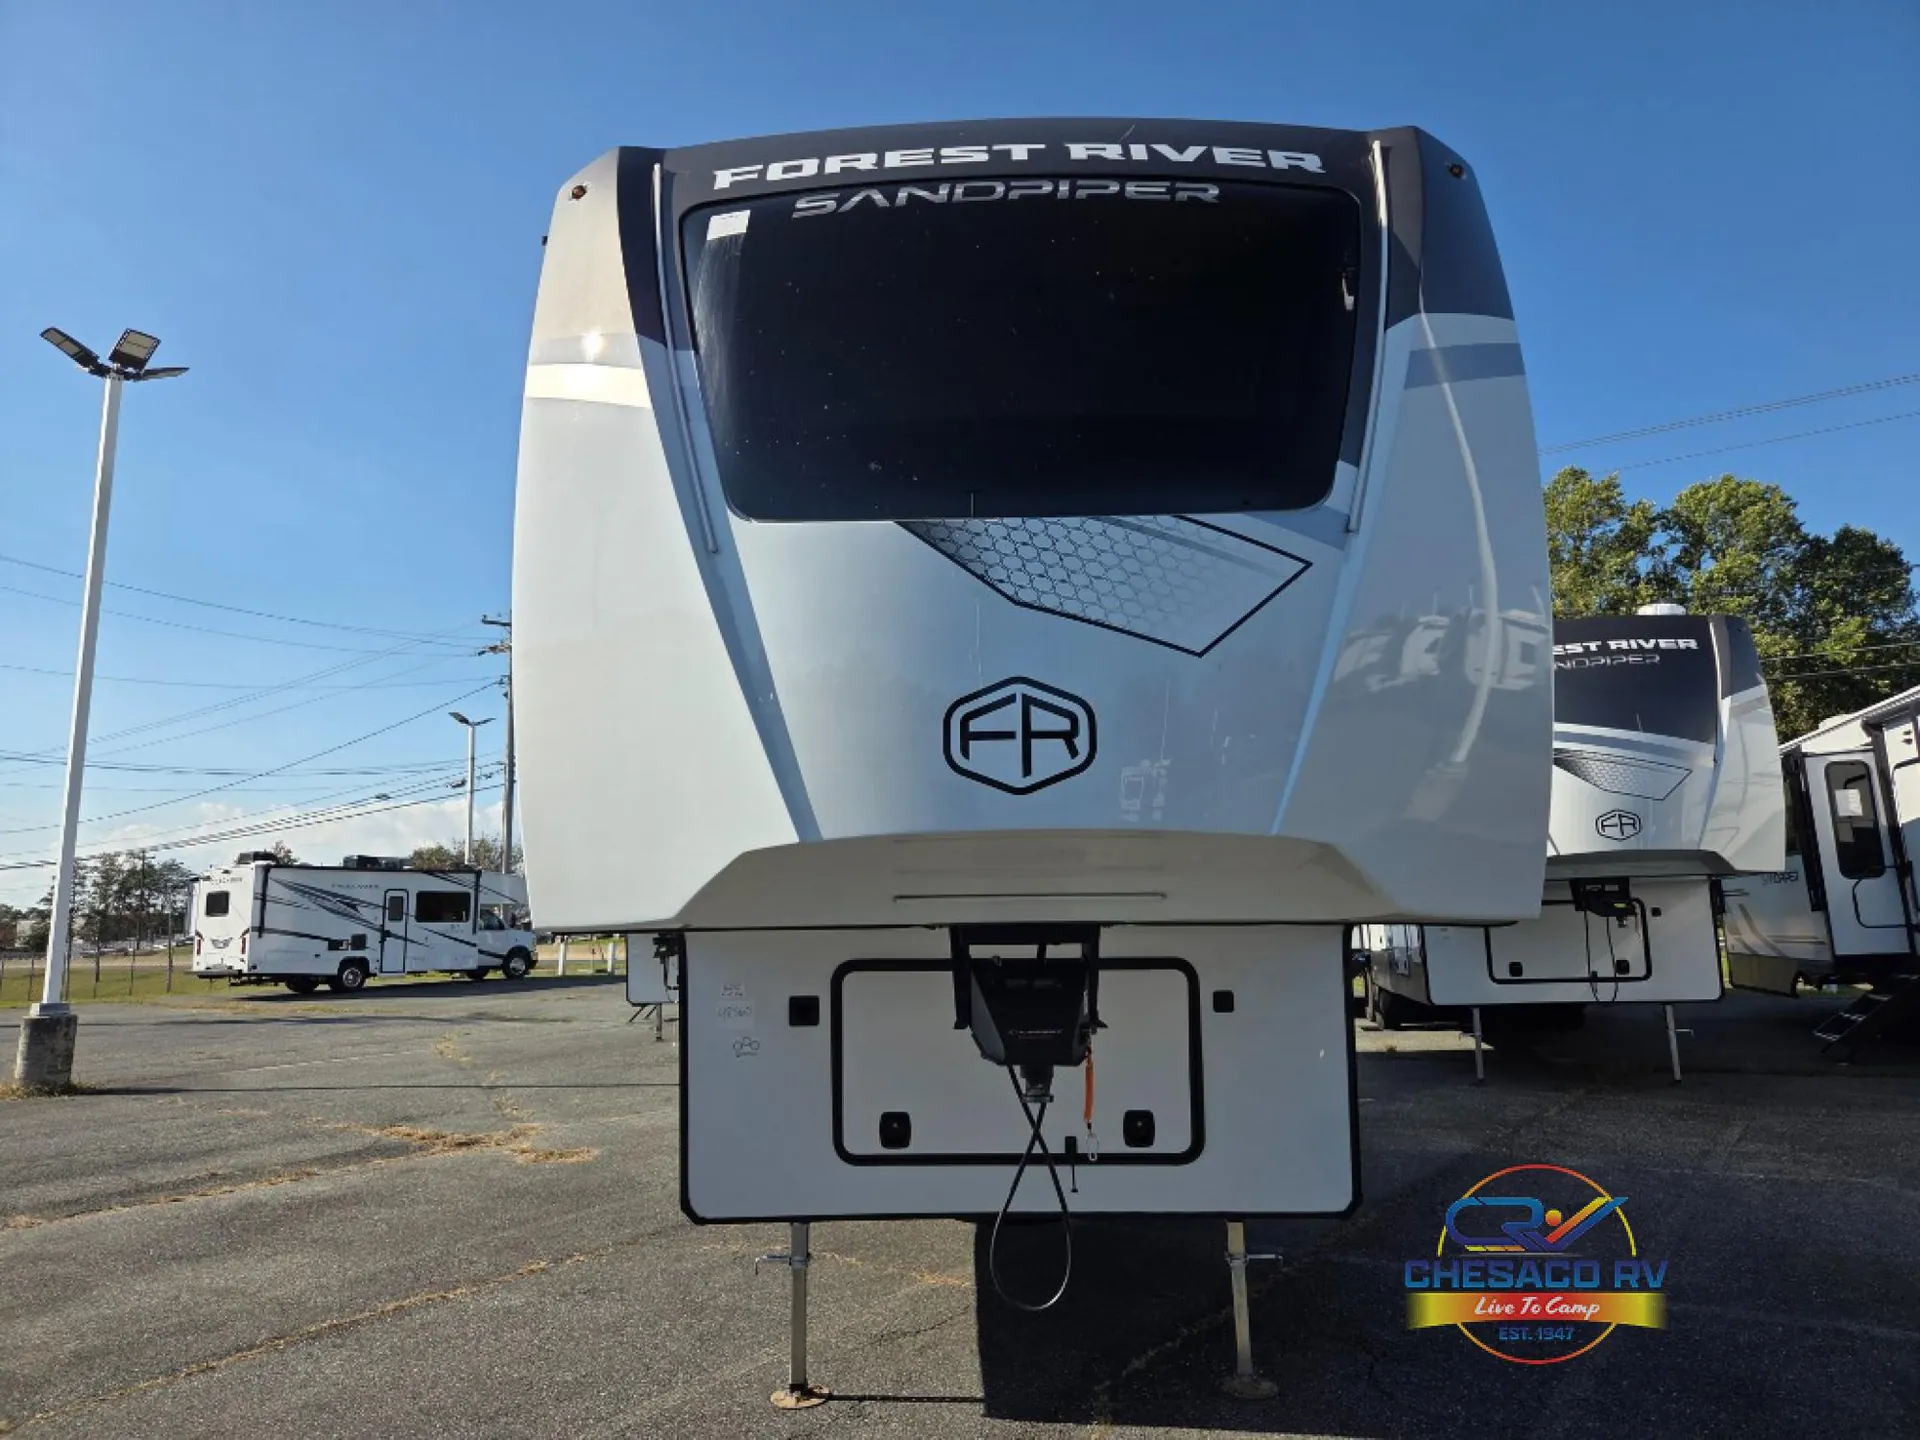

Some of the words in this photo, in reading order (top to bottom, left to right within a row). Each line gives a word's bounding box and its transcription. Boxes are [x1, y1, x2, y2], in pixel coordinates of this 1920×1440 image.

[713, 144, 1046, 190] FOREST
[1064, 143, 1326, 173] RIVER
[792, 180, 1220, 219] SANDPIPER
[1552, 641, 1602, 655] EST
[1607, 638, 1699, 650] RIVER
